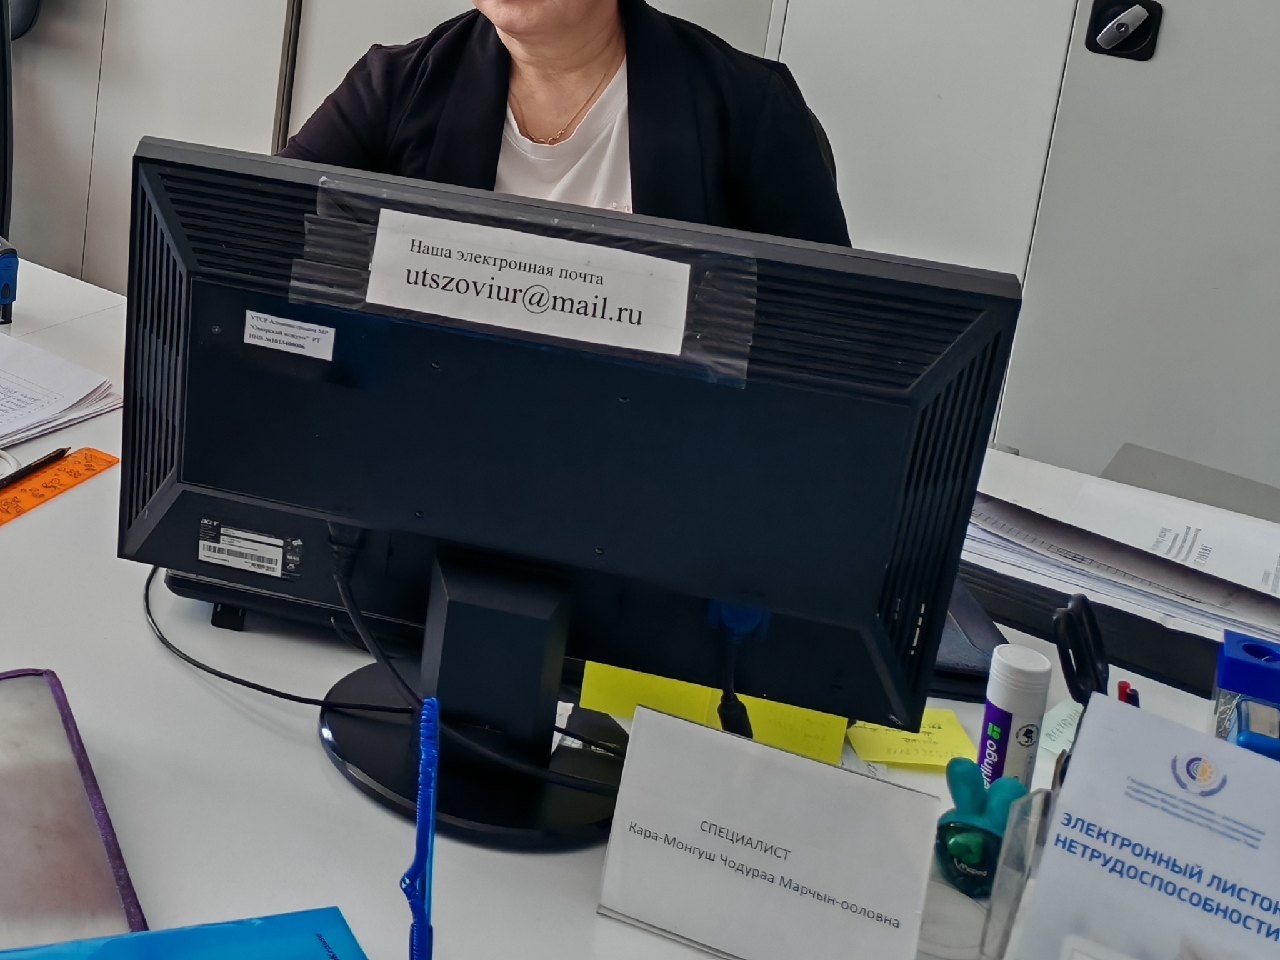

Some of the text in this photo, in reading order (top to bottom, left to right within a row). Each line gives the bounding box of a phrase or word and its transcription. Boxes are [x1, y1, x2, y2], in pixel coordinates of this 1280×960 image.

[410, 238, 604, 285] Наша электронная почта
[405, 266, 643, 326] utszoviur@mail.ru
[980, 740, 998, 790] erlingo
[700, 820, 792, 861] СПЕЦИАЛИСТ
[1060, 812, 1204, 883] ЭЛЕКТРОННЫЙ
[628, 821, 900, 929] Кара-Монгуш Чодураа Марчын-ооловна
[1054, 833, 1280, 942] НЕТРУДОСПОСОБНОСТИ
